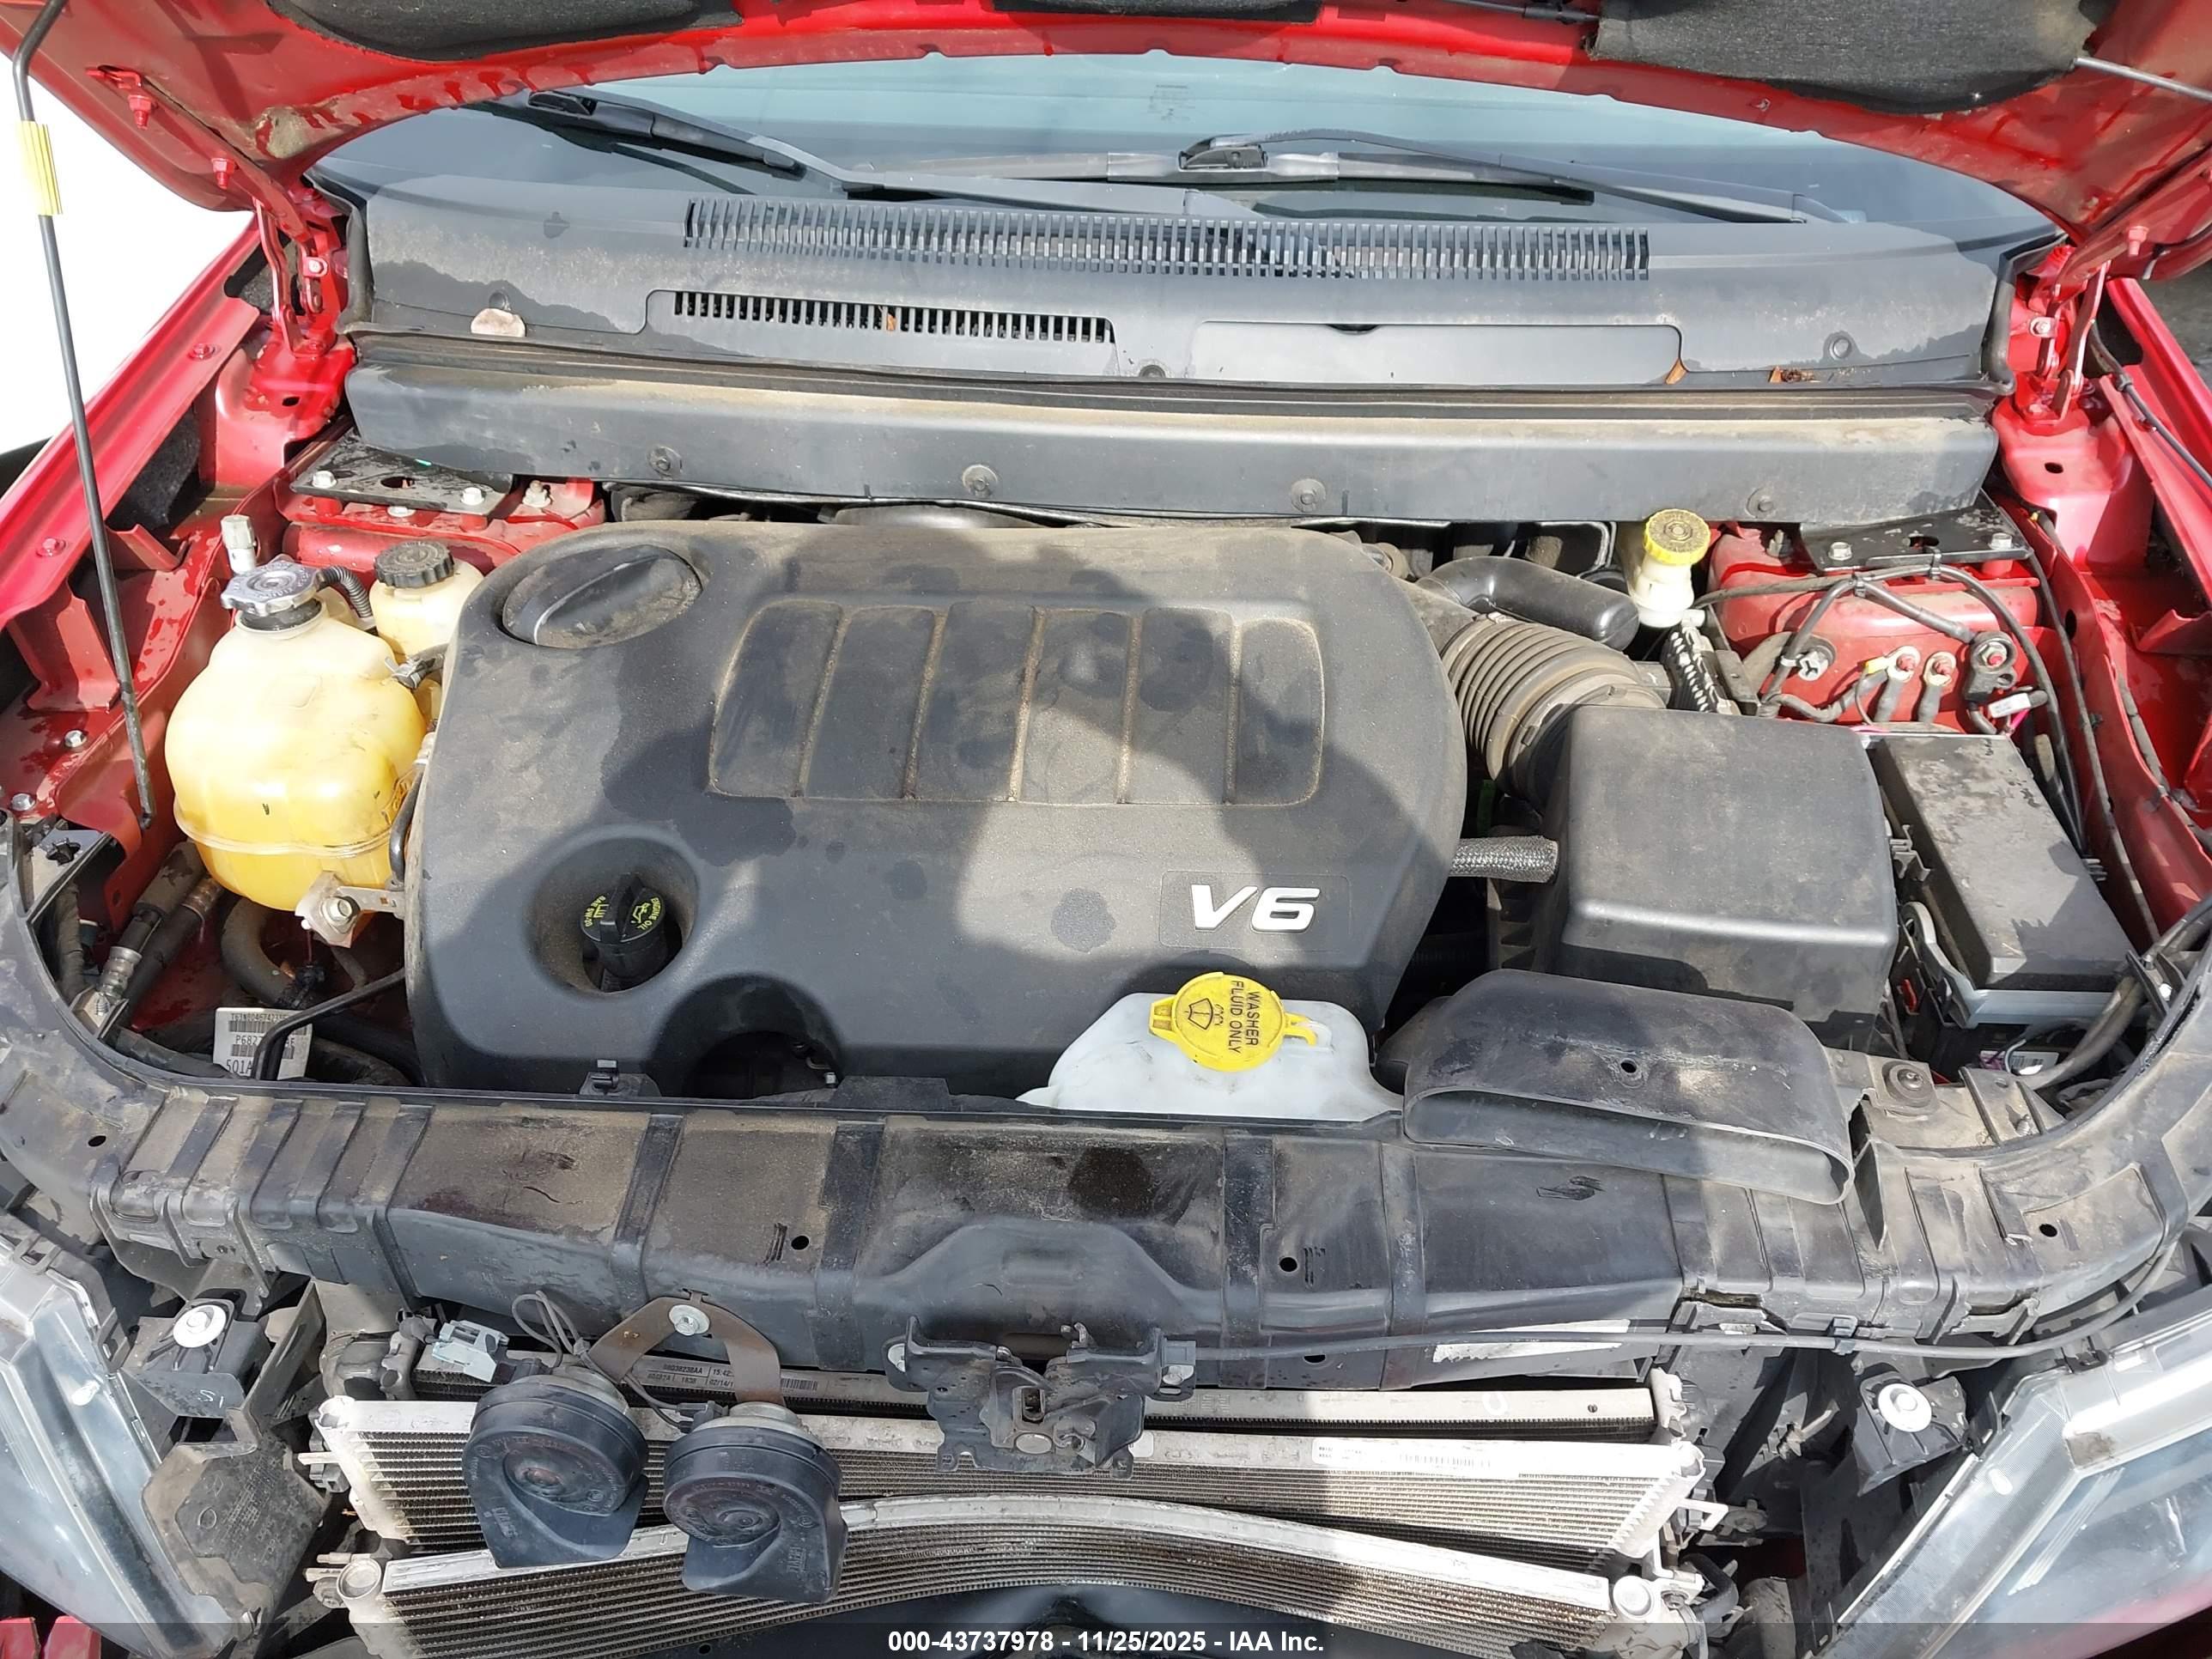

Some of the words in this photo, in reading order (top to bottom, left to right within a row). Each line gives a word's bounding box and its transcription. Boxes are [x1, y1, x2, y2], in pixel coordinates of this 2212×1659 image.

[636, 920, 653, 930] OIL
[648, 897, 661, 921] ENGINE
[1190, 884, 1321, 933] V6
[1230, 980, 1244, 1016] FLUID
[1245, 991, 1261, 1046] WASHER
[1227, 1020, 1243, 1054] ONLY
